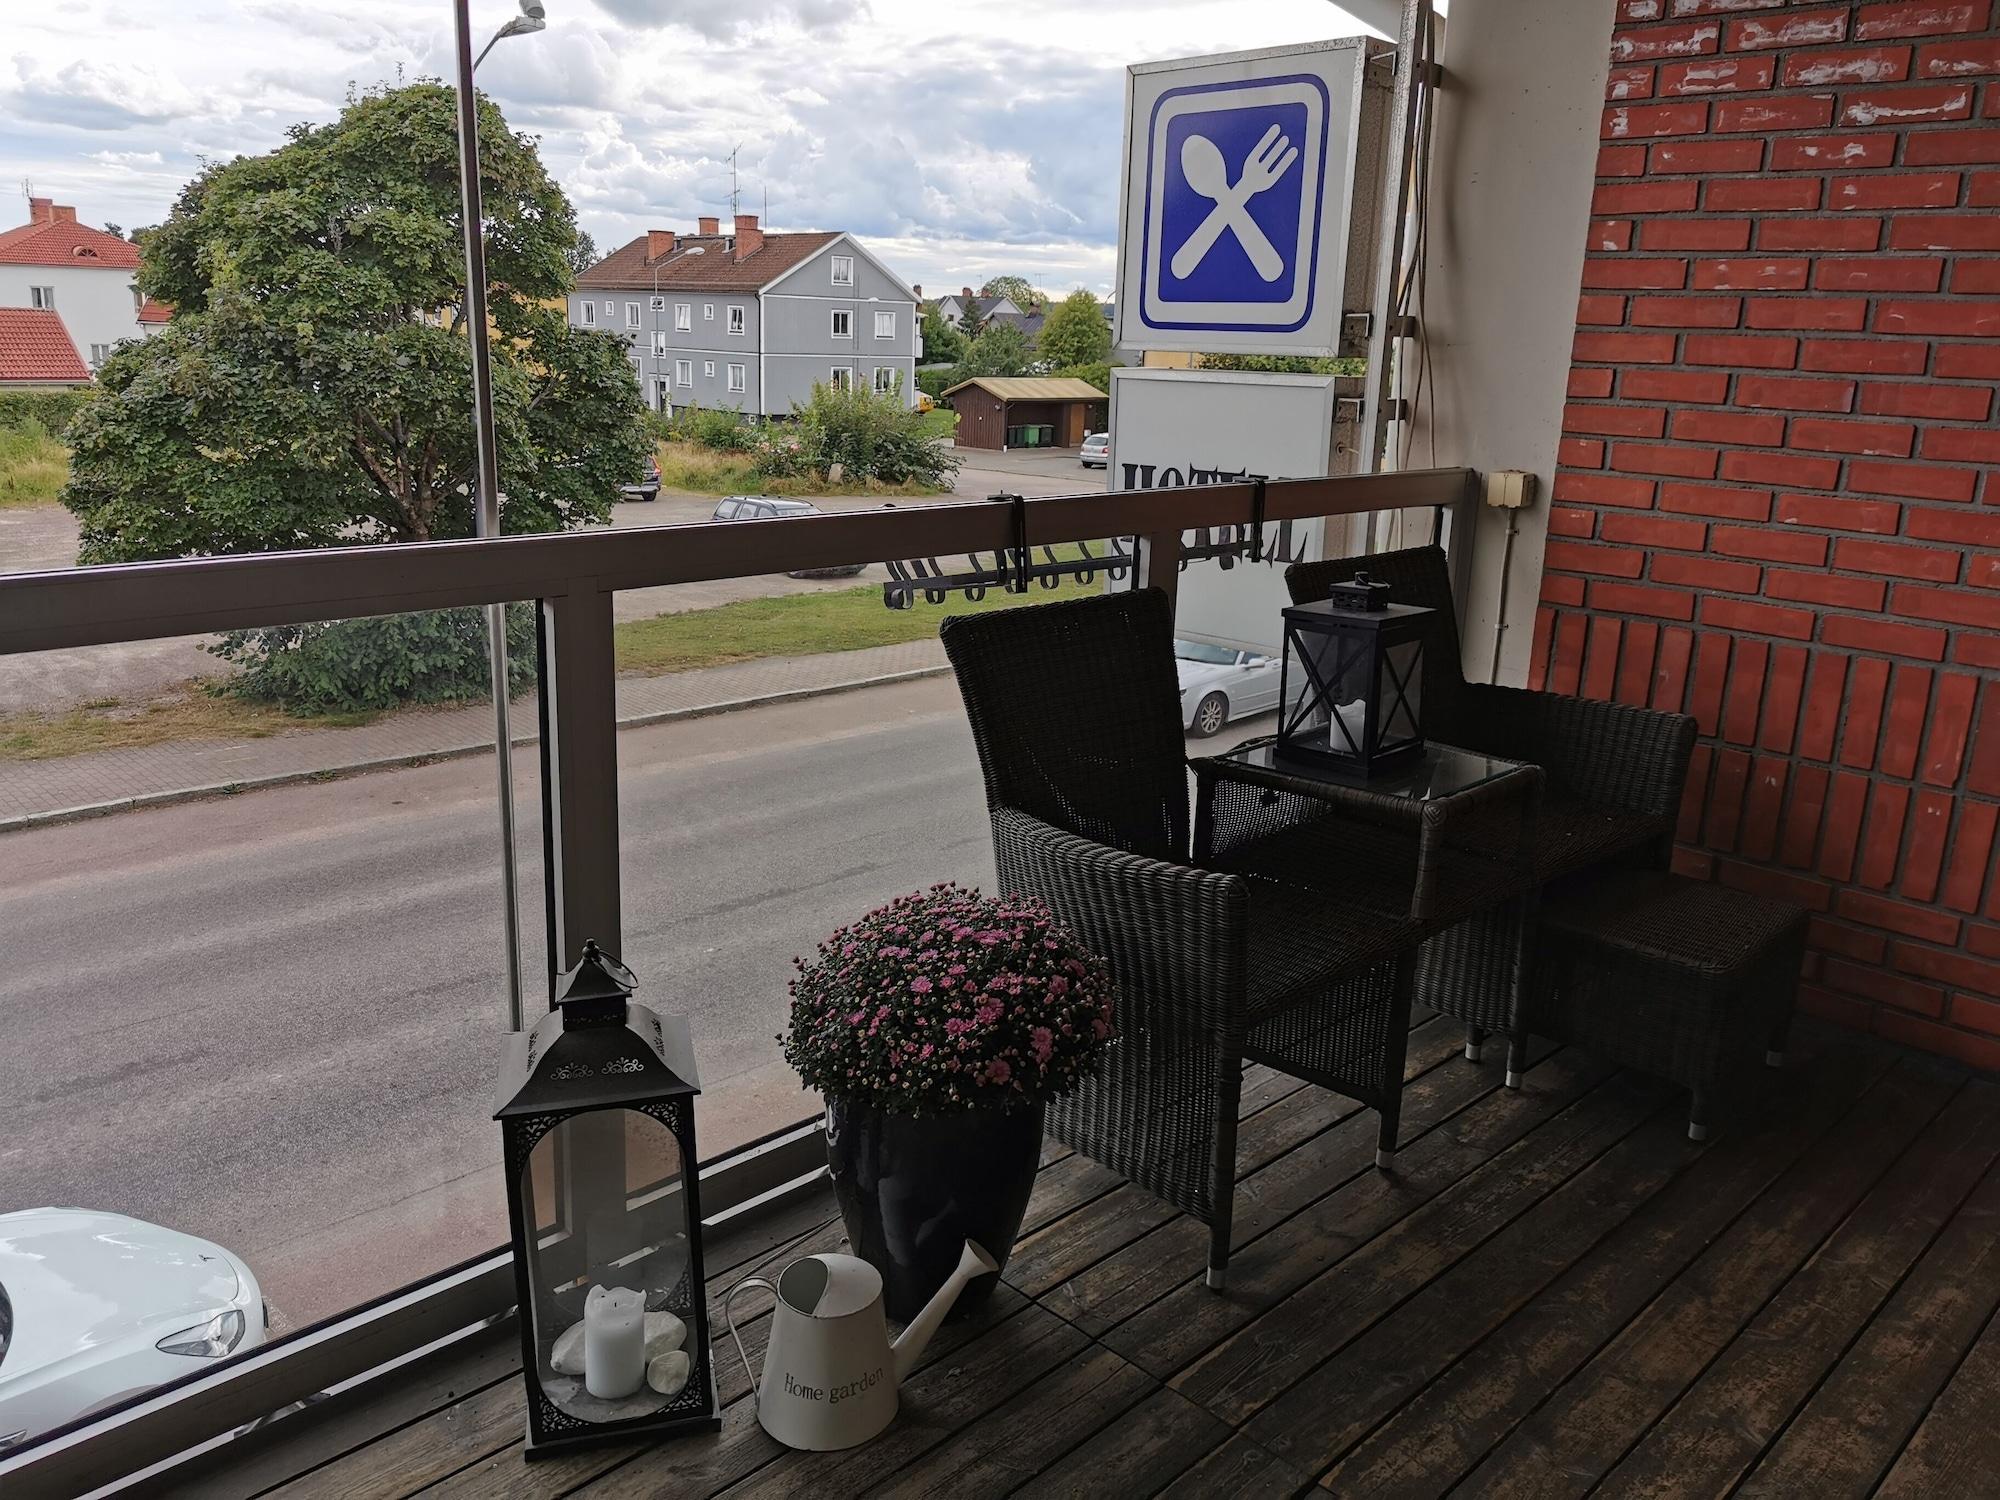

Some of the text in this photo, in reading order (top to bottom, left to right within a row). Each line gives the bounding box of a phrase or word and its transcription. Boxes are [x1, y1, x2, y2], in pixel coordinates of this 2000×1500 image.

[1121, 462, 1308, 568] TELL
[784, 1367, 884, 1404] Home garden
